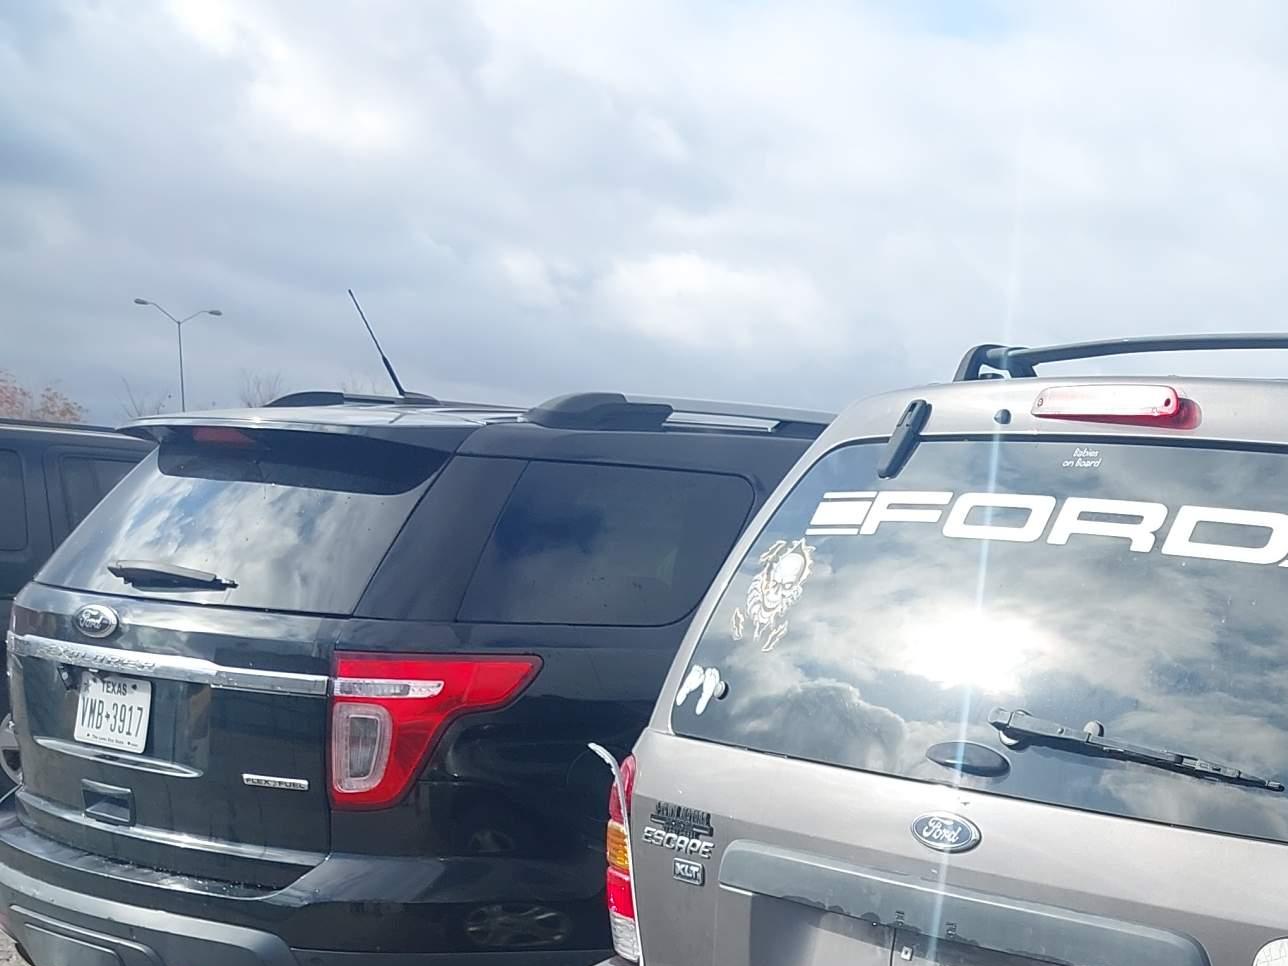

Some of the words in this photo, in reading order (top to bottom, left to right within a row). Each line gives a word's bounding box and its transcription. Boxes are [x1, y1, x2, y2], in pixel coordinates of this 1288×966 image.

[102, 679, 127, 696] TEXAS
[922, 817, 962, 843] Ford
[643, 826, 715, 859] ESCAPE
[675, 862, 700, 880] XLT
